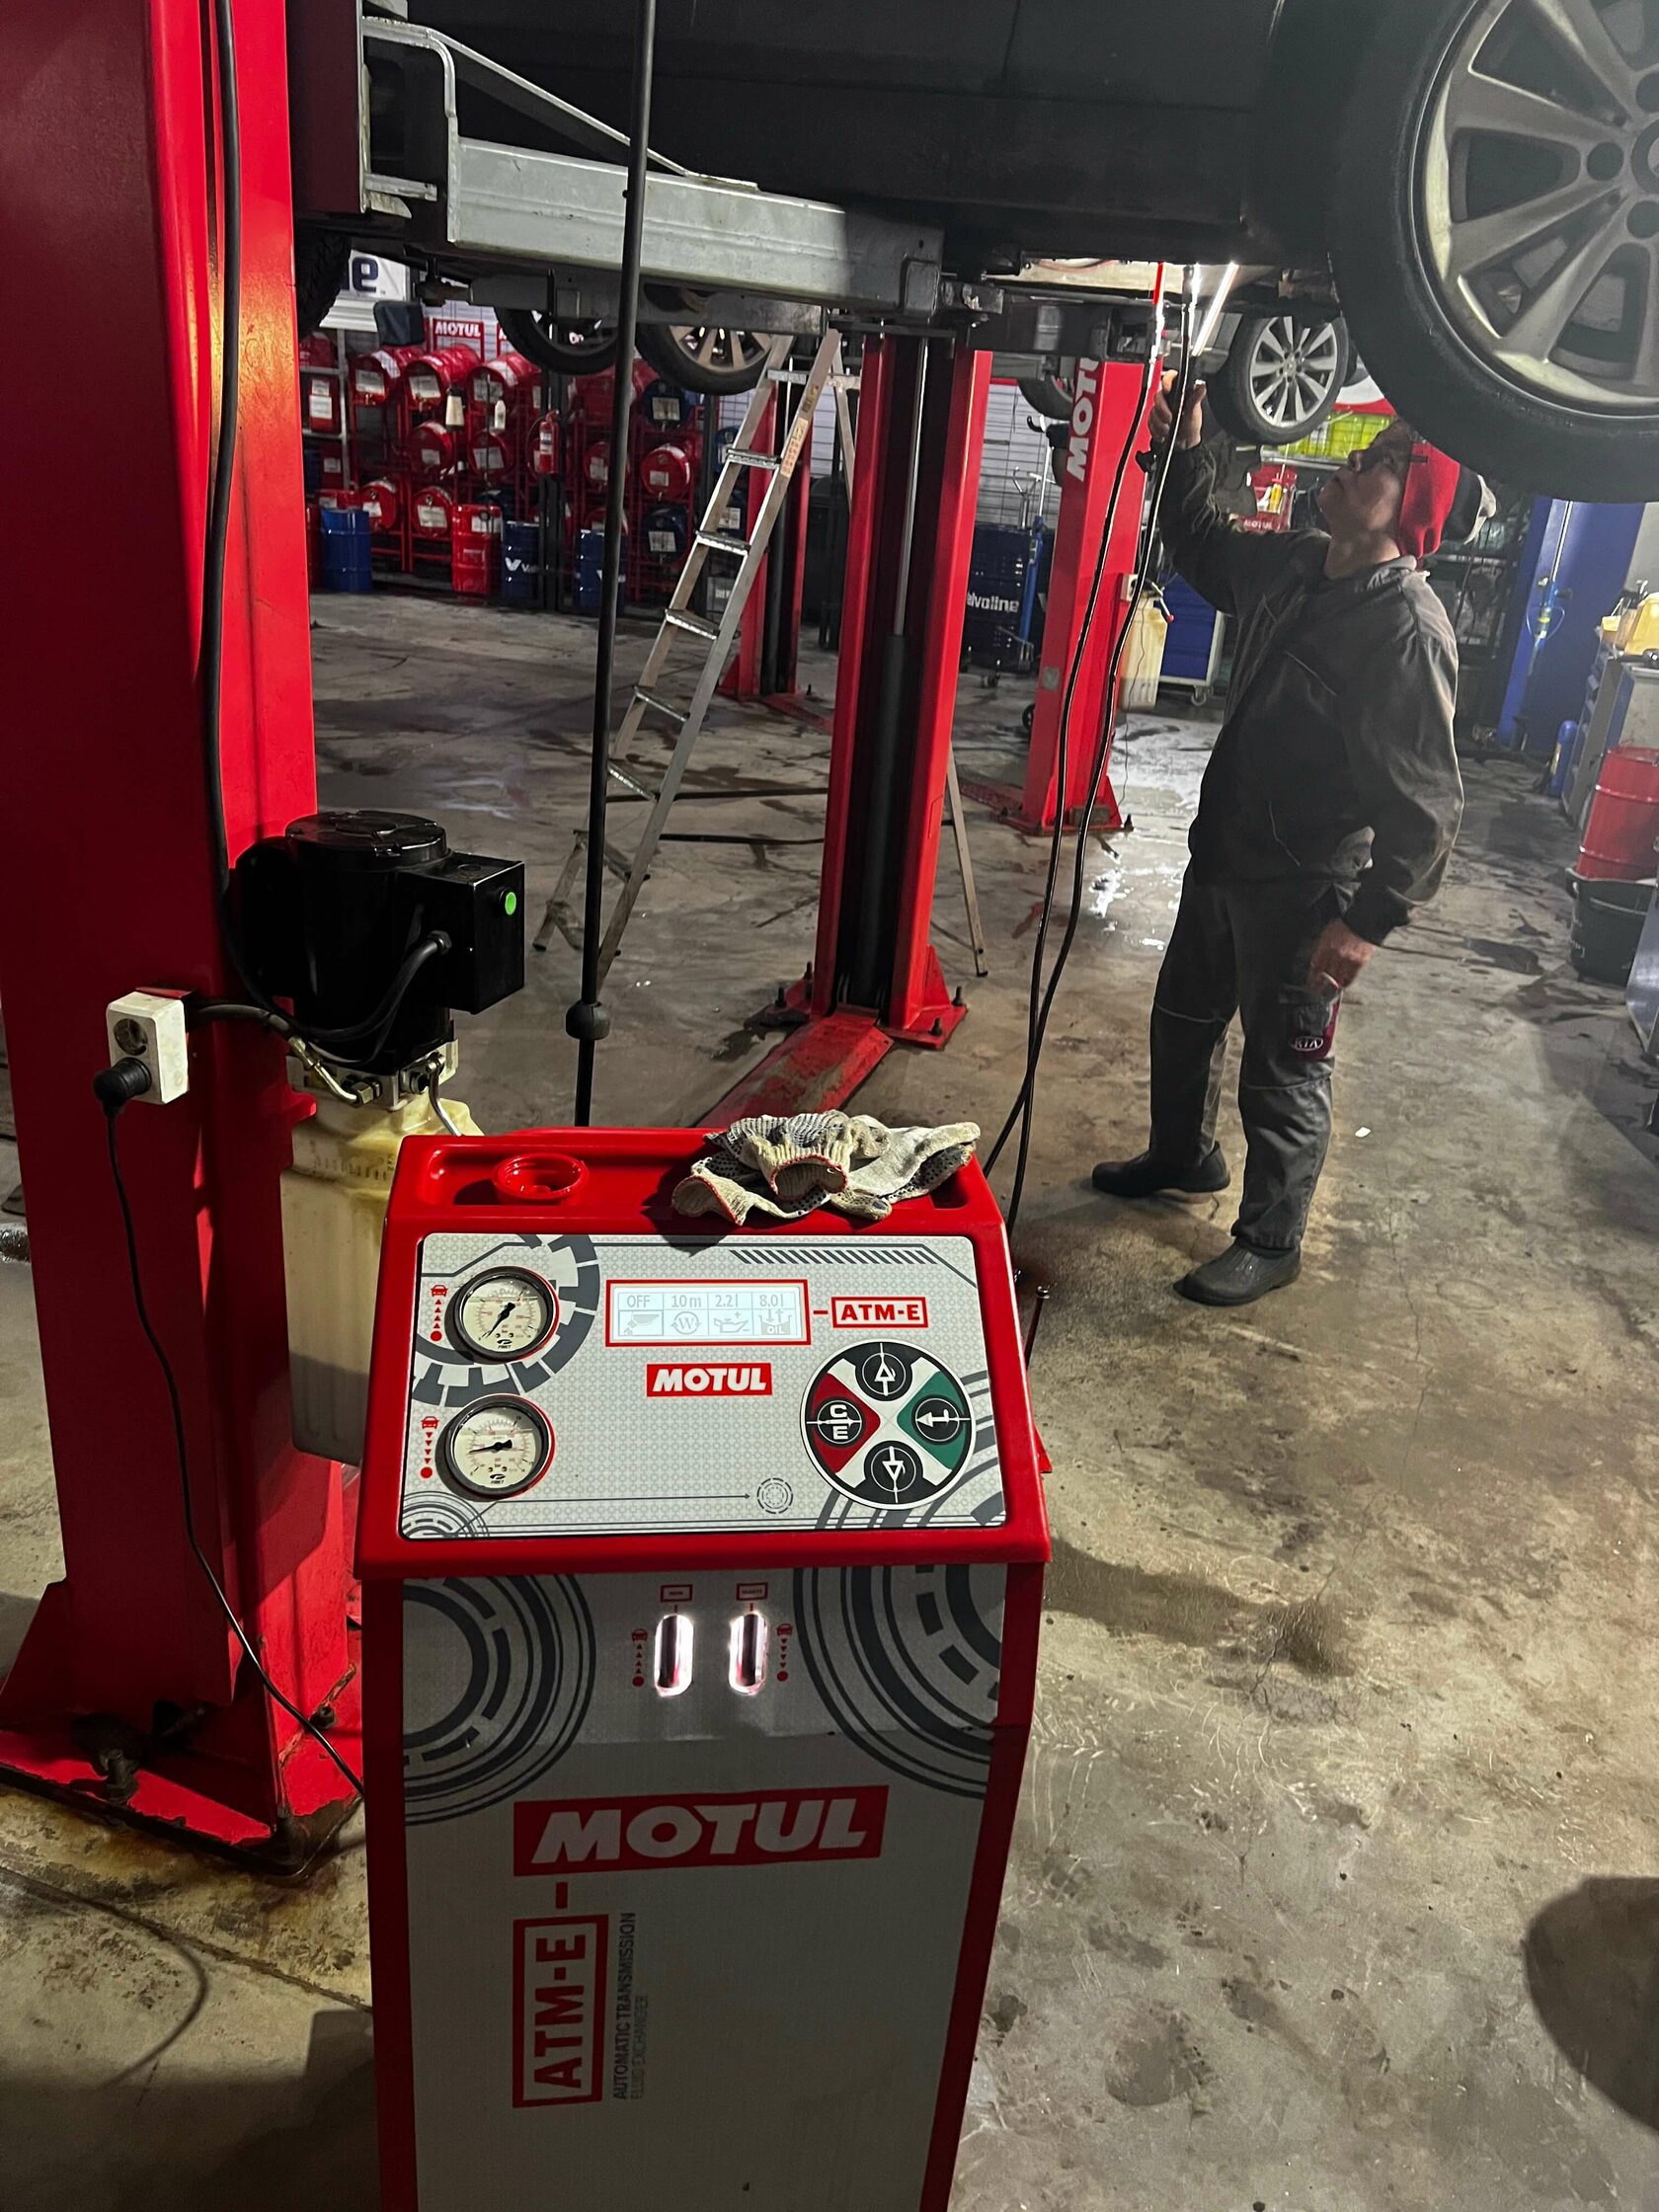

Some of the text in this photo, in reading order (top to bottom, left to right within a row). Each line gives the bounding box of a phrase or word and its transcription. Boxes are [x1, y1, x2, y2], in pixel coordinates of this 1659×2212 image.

[434, 321, 481, 338] MOTUL
[1243, 518, 1273, 530] MOTUL
[967, 591, 1020, 613] alvoline
[626, 1295, 651, 1308] OFF
[840, 1304, 921, 1321] ATM-E
[766, 1325, 785, 1334] OIL
[652, 1368, 766, 1392] MOTUL
[530, 1798, 867, 1864] MOTUL
[533, 1934, 587, 2090] ATM-E
[612, 1912, 636, 2100] AUTOMATIC TRANSMISSION
